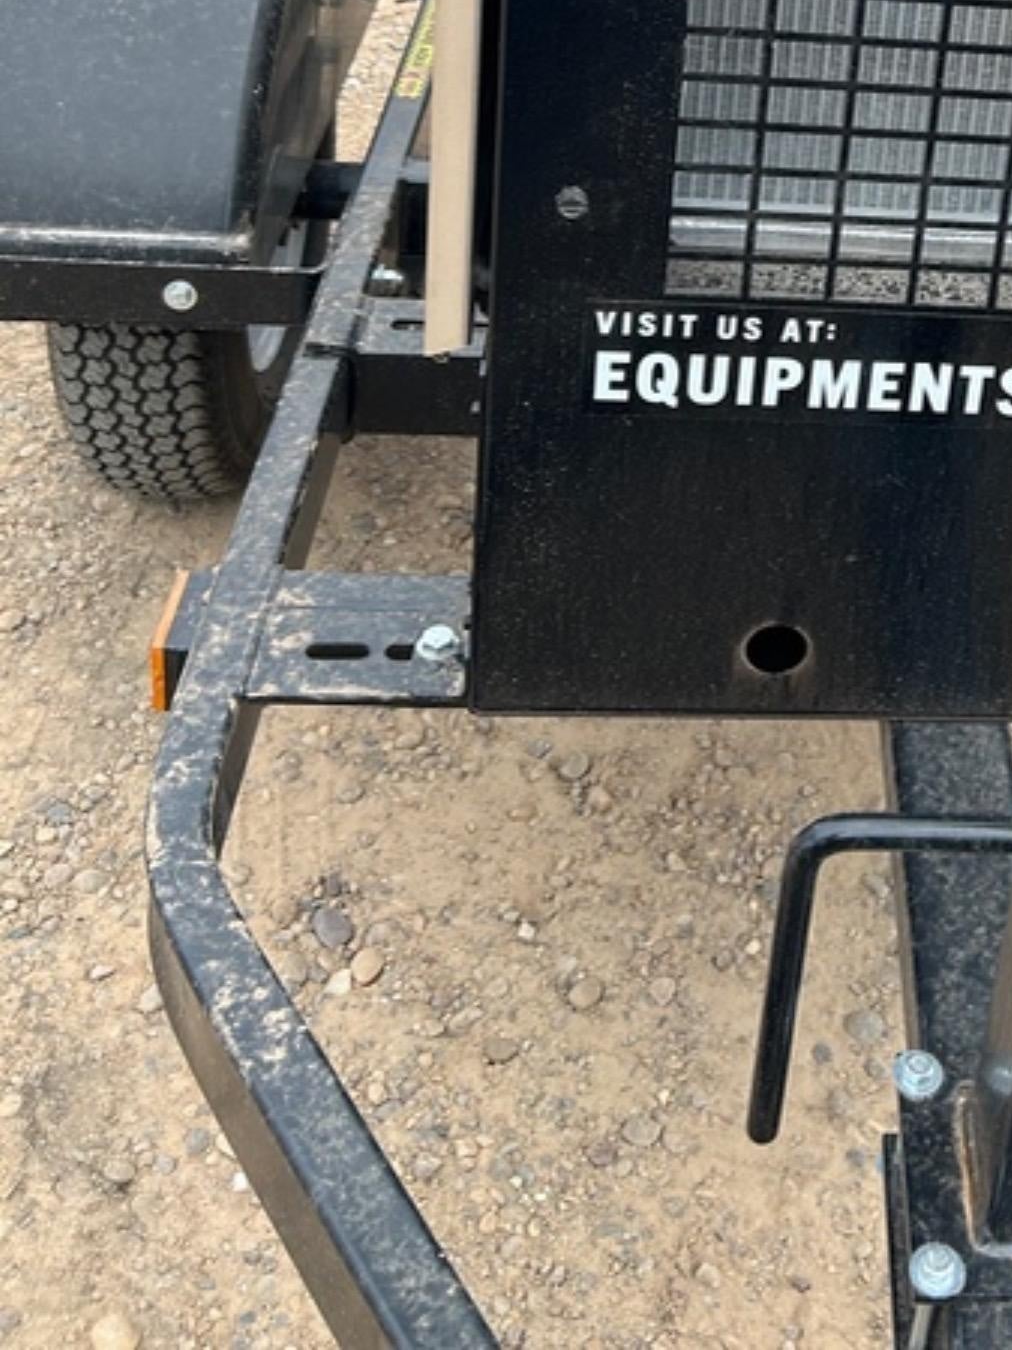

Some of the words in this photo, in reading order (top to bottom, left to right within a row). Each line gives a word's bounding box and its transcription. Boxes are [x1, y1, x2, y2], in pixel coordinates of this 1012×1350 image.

[595, 310, 699, 338] VISIT
[716, 314, 763, 341] US
[780, 317, 838, 344] AT:
